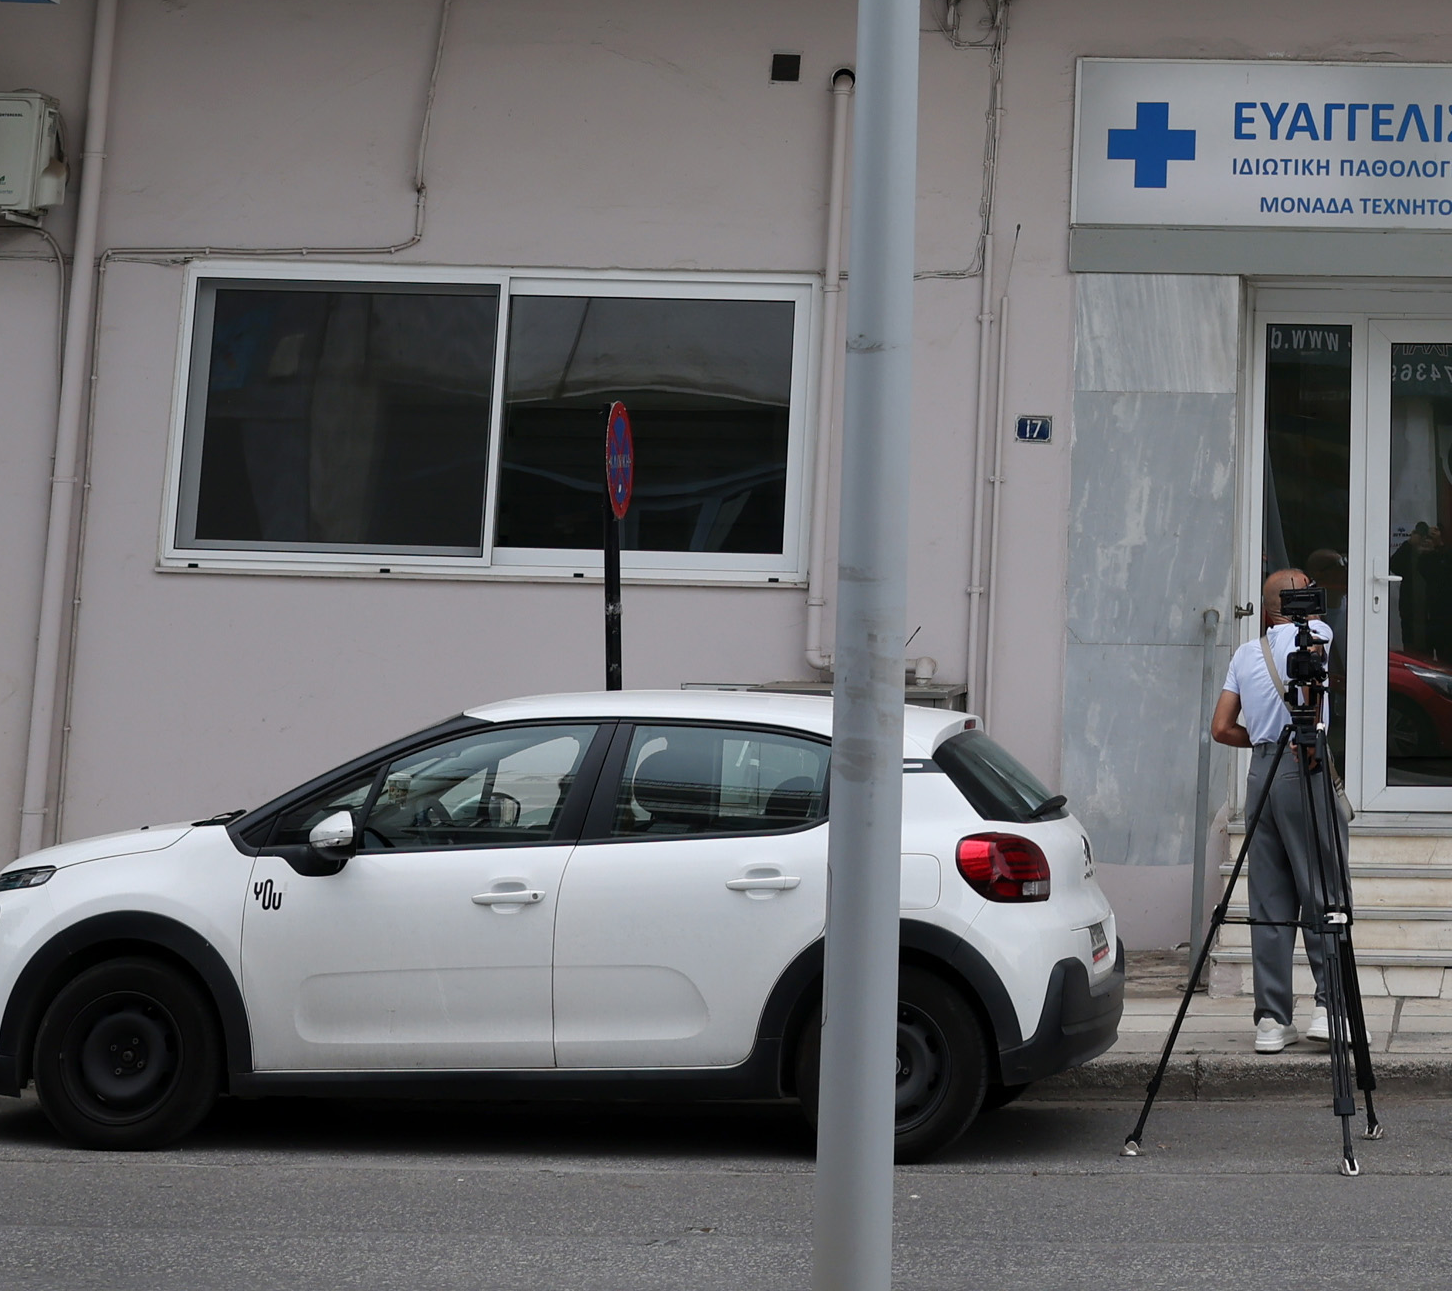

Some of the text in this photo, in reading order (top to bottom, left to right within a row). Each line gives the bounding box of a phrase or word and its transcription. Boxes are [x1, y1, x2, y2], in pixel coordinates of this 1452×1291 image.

[1232, 158, 1330, 176] ΙΔΙΩΤΙΚΗ
[1260, 197, 1354, 214] ΜΟΝΑΔΑ
[1026, 420, 1042, 438] 17
